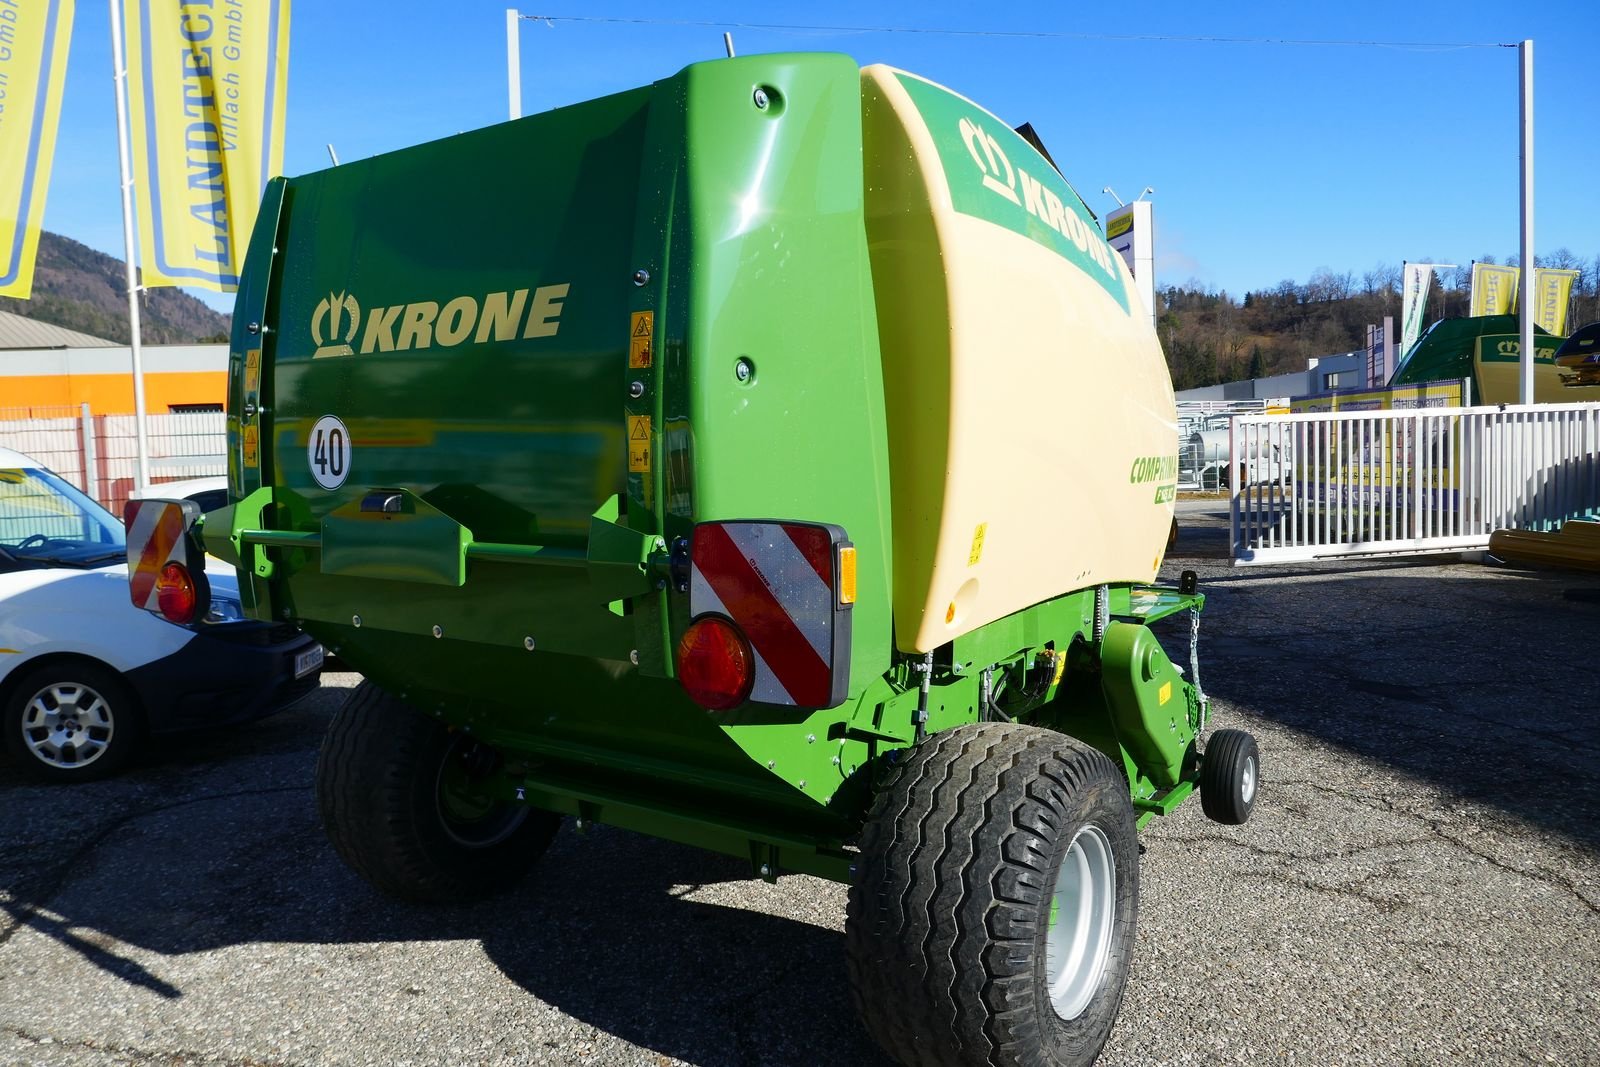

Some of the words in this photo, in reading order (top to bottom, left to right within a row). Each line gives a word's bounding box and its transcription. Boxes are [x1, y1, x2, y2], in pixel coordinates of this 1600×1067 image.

[221, 72, 240, 151] Villach
[1018, 168, 1117, 281] KRONE
[359, 283, 571, 354] KRONE
[314, 428, 343, 477] 40
